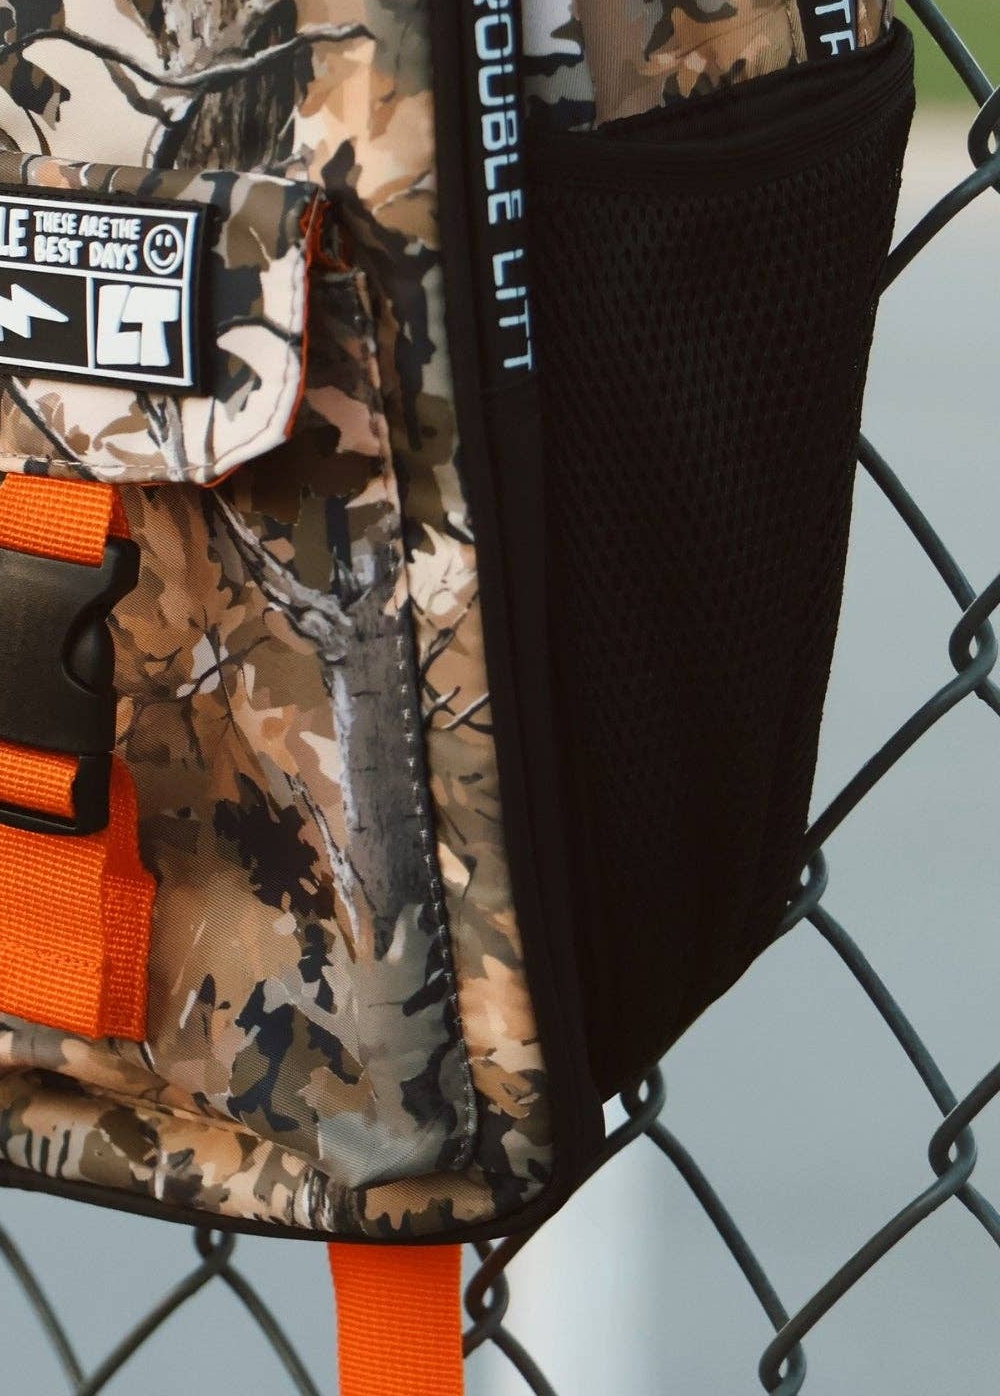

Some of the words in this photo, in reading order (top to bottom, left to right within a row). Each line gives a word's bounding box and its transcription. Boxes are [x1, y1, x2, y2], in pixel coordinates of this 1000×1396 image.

[33, 210, 78, 236] THESE
[78, 214, 109, 239] ARE
[108, 217, 142, 241] THE
[33, 234, 83, 266] BEST
[88, 241, 138, 272] DAYS
[96, 283, 181, 368] LT
[492, 248, 533, 372] LITT
